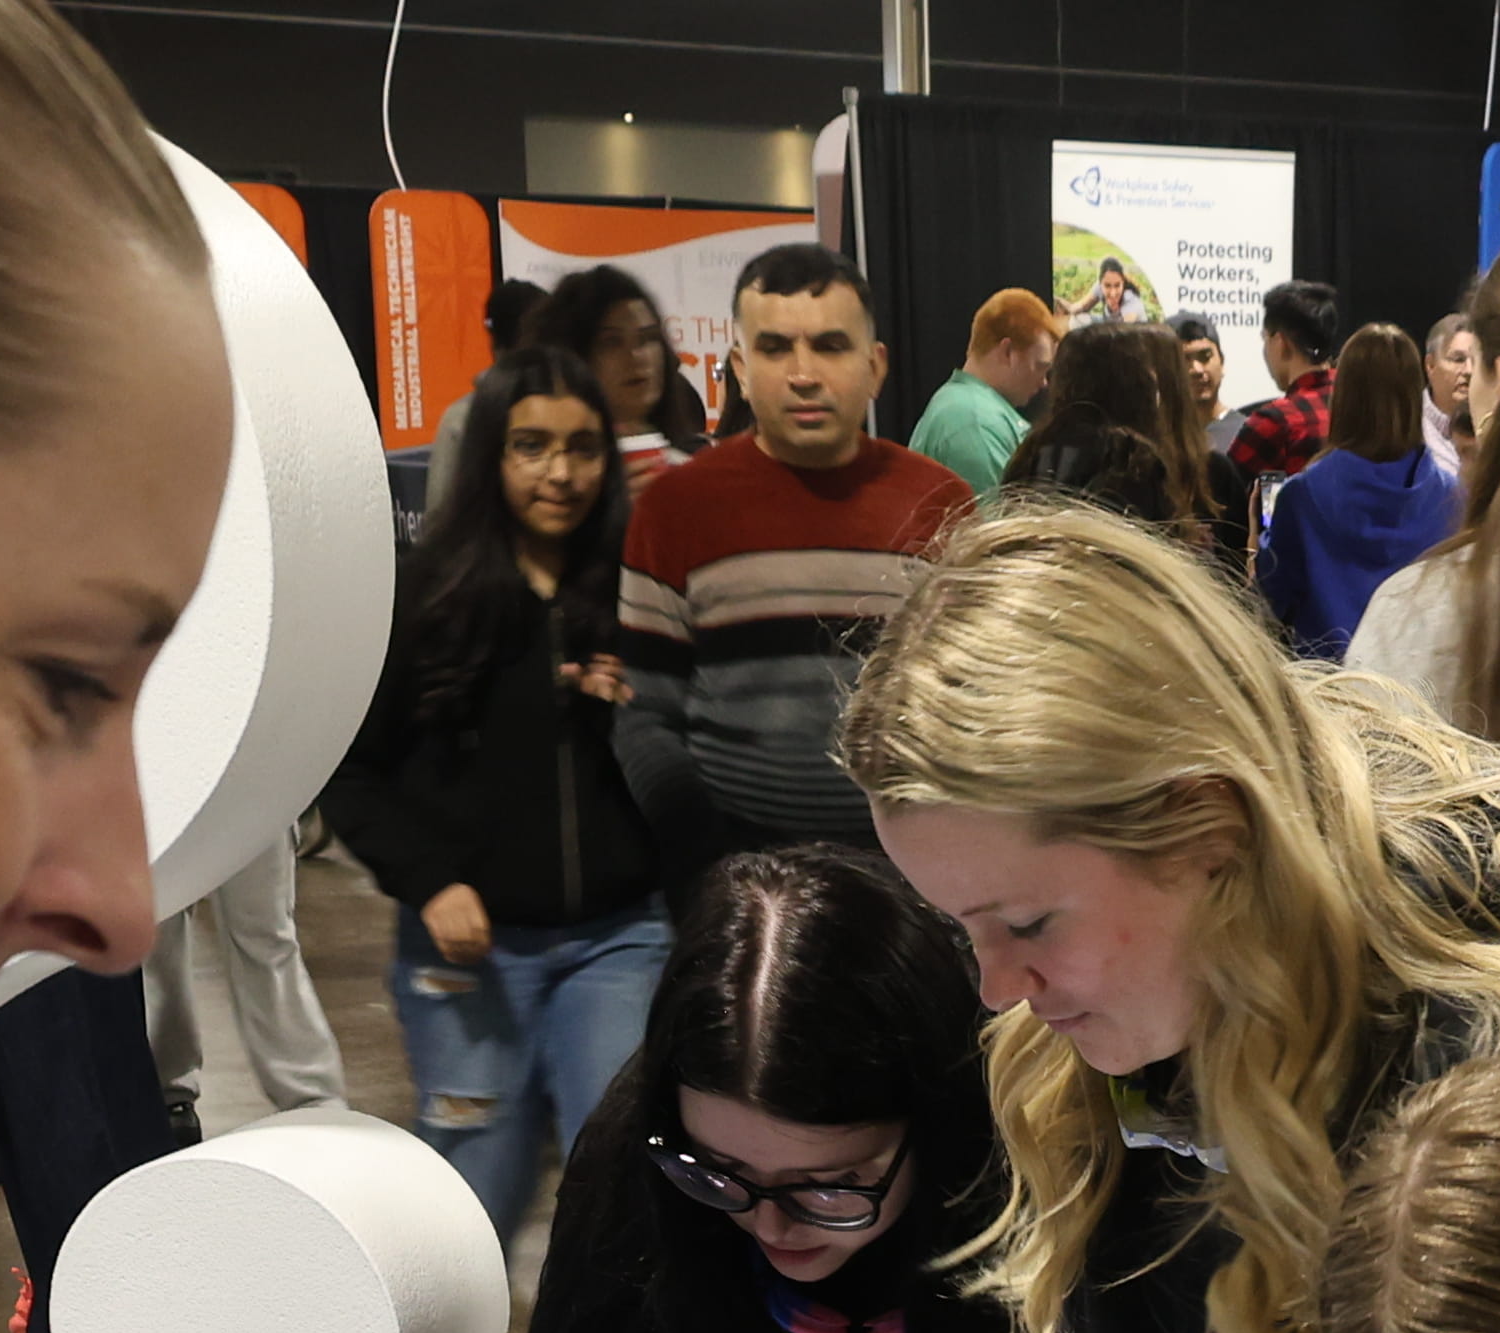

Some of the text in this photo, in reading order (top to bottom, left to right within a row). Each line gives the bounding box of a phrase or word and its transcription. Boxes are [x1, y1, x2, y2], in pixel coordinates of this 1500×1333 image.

[1177, 240, 1273, 263] Protecting
[1177, 264, 1260, 286] Workers,
[1178, 286, 1265, 305] Protectin
